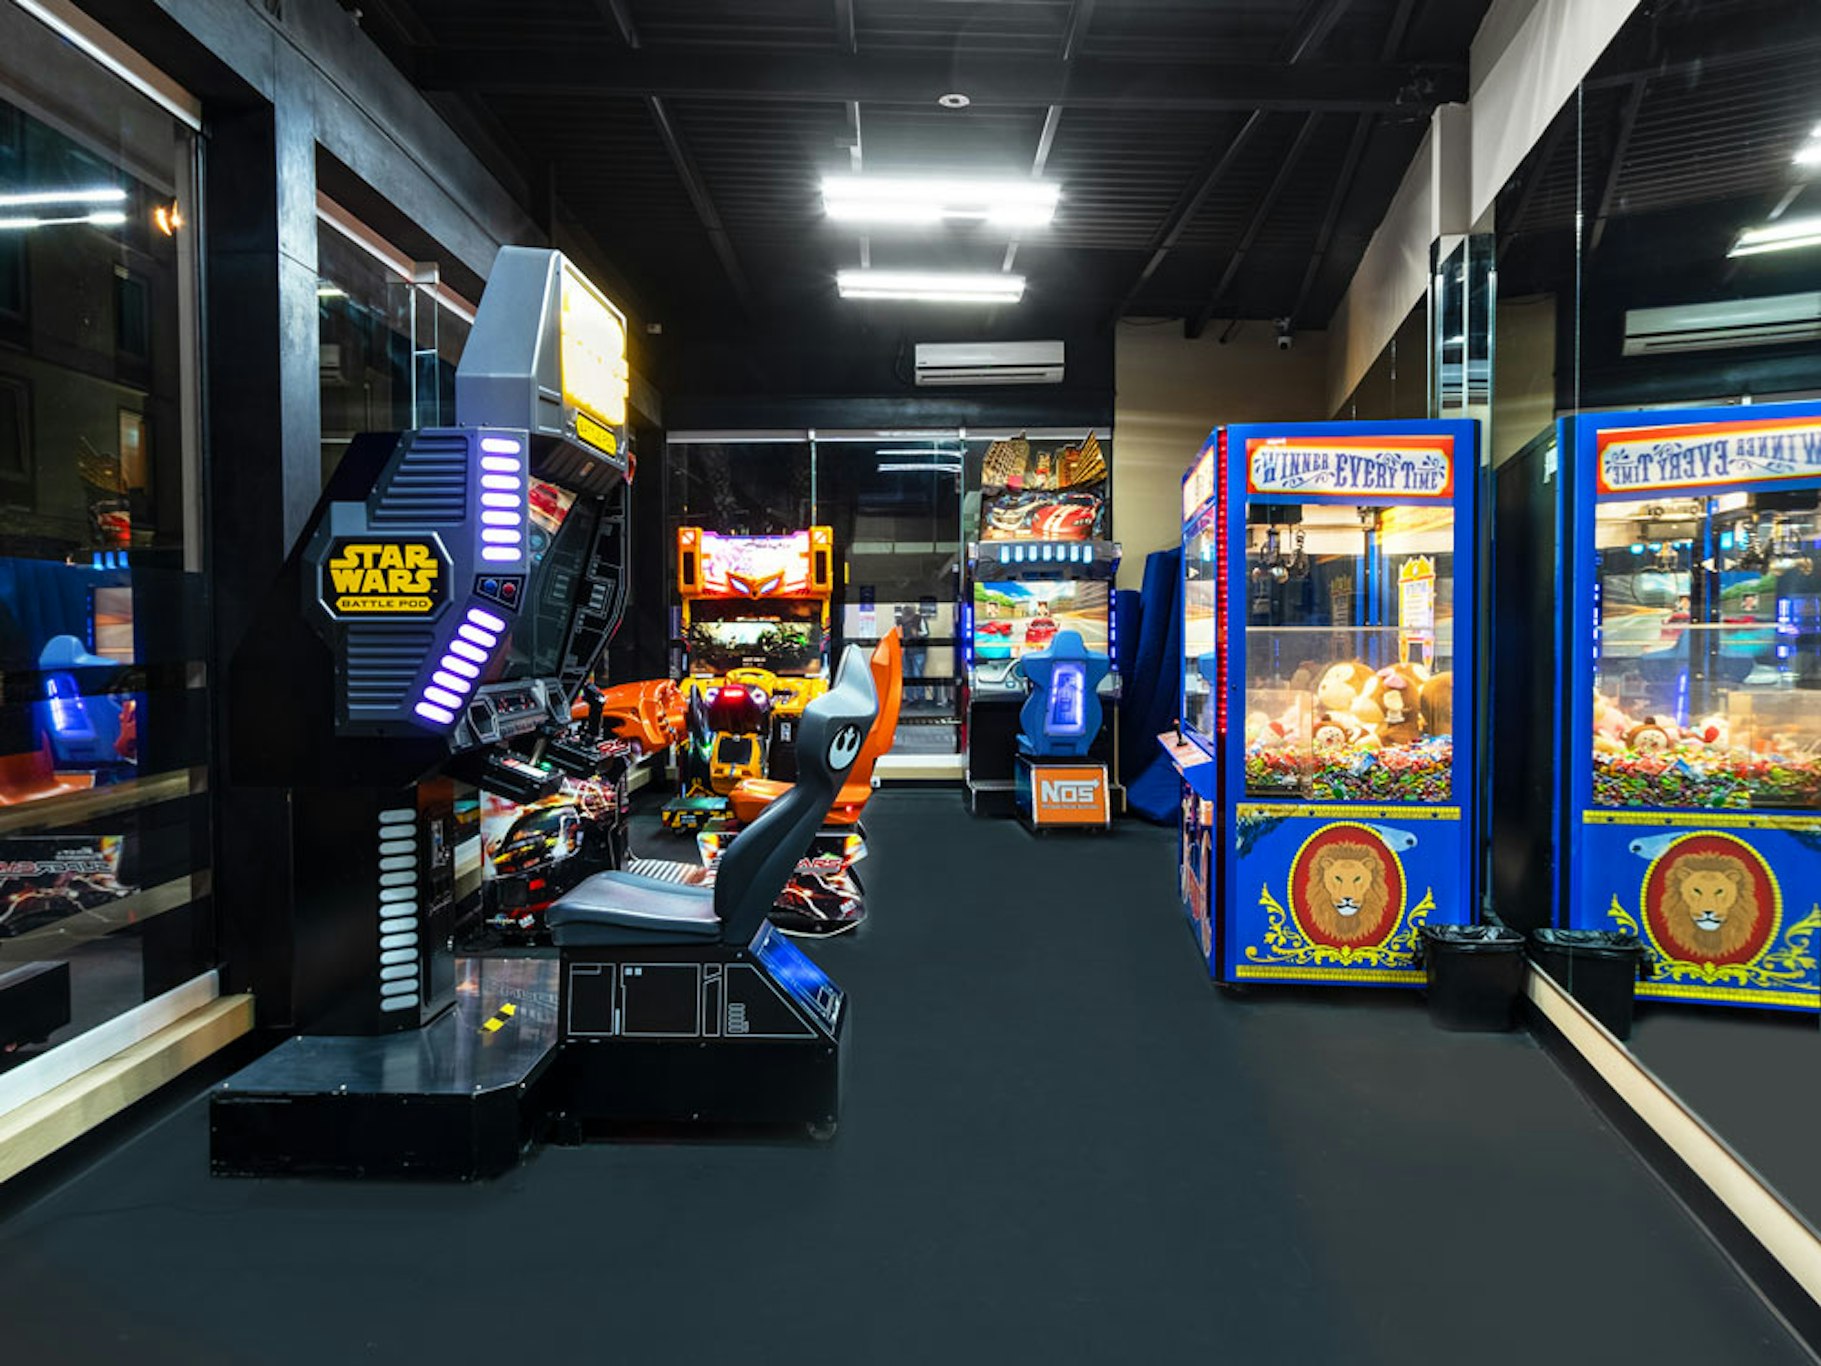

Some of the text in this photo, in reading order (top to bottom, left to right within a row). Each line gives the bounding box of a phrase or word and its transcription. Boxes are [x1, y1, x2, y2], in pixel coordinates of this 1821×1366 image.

[1261, 451, 1438, 490] WINNER EVERY TIME
[329, 543, 439, 570] STAR
[330, 568, 439, 594] WARS
[341, 600, 429, 608] BATTLE POD
[1041, 779, 1099, 803] NOS
